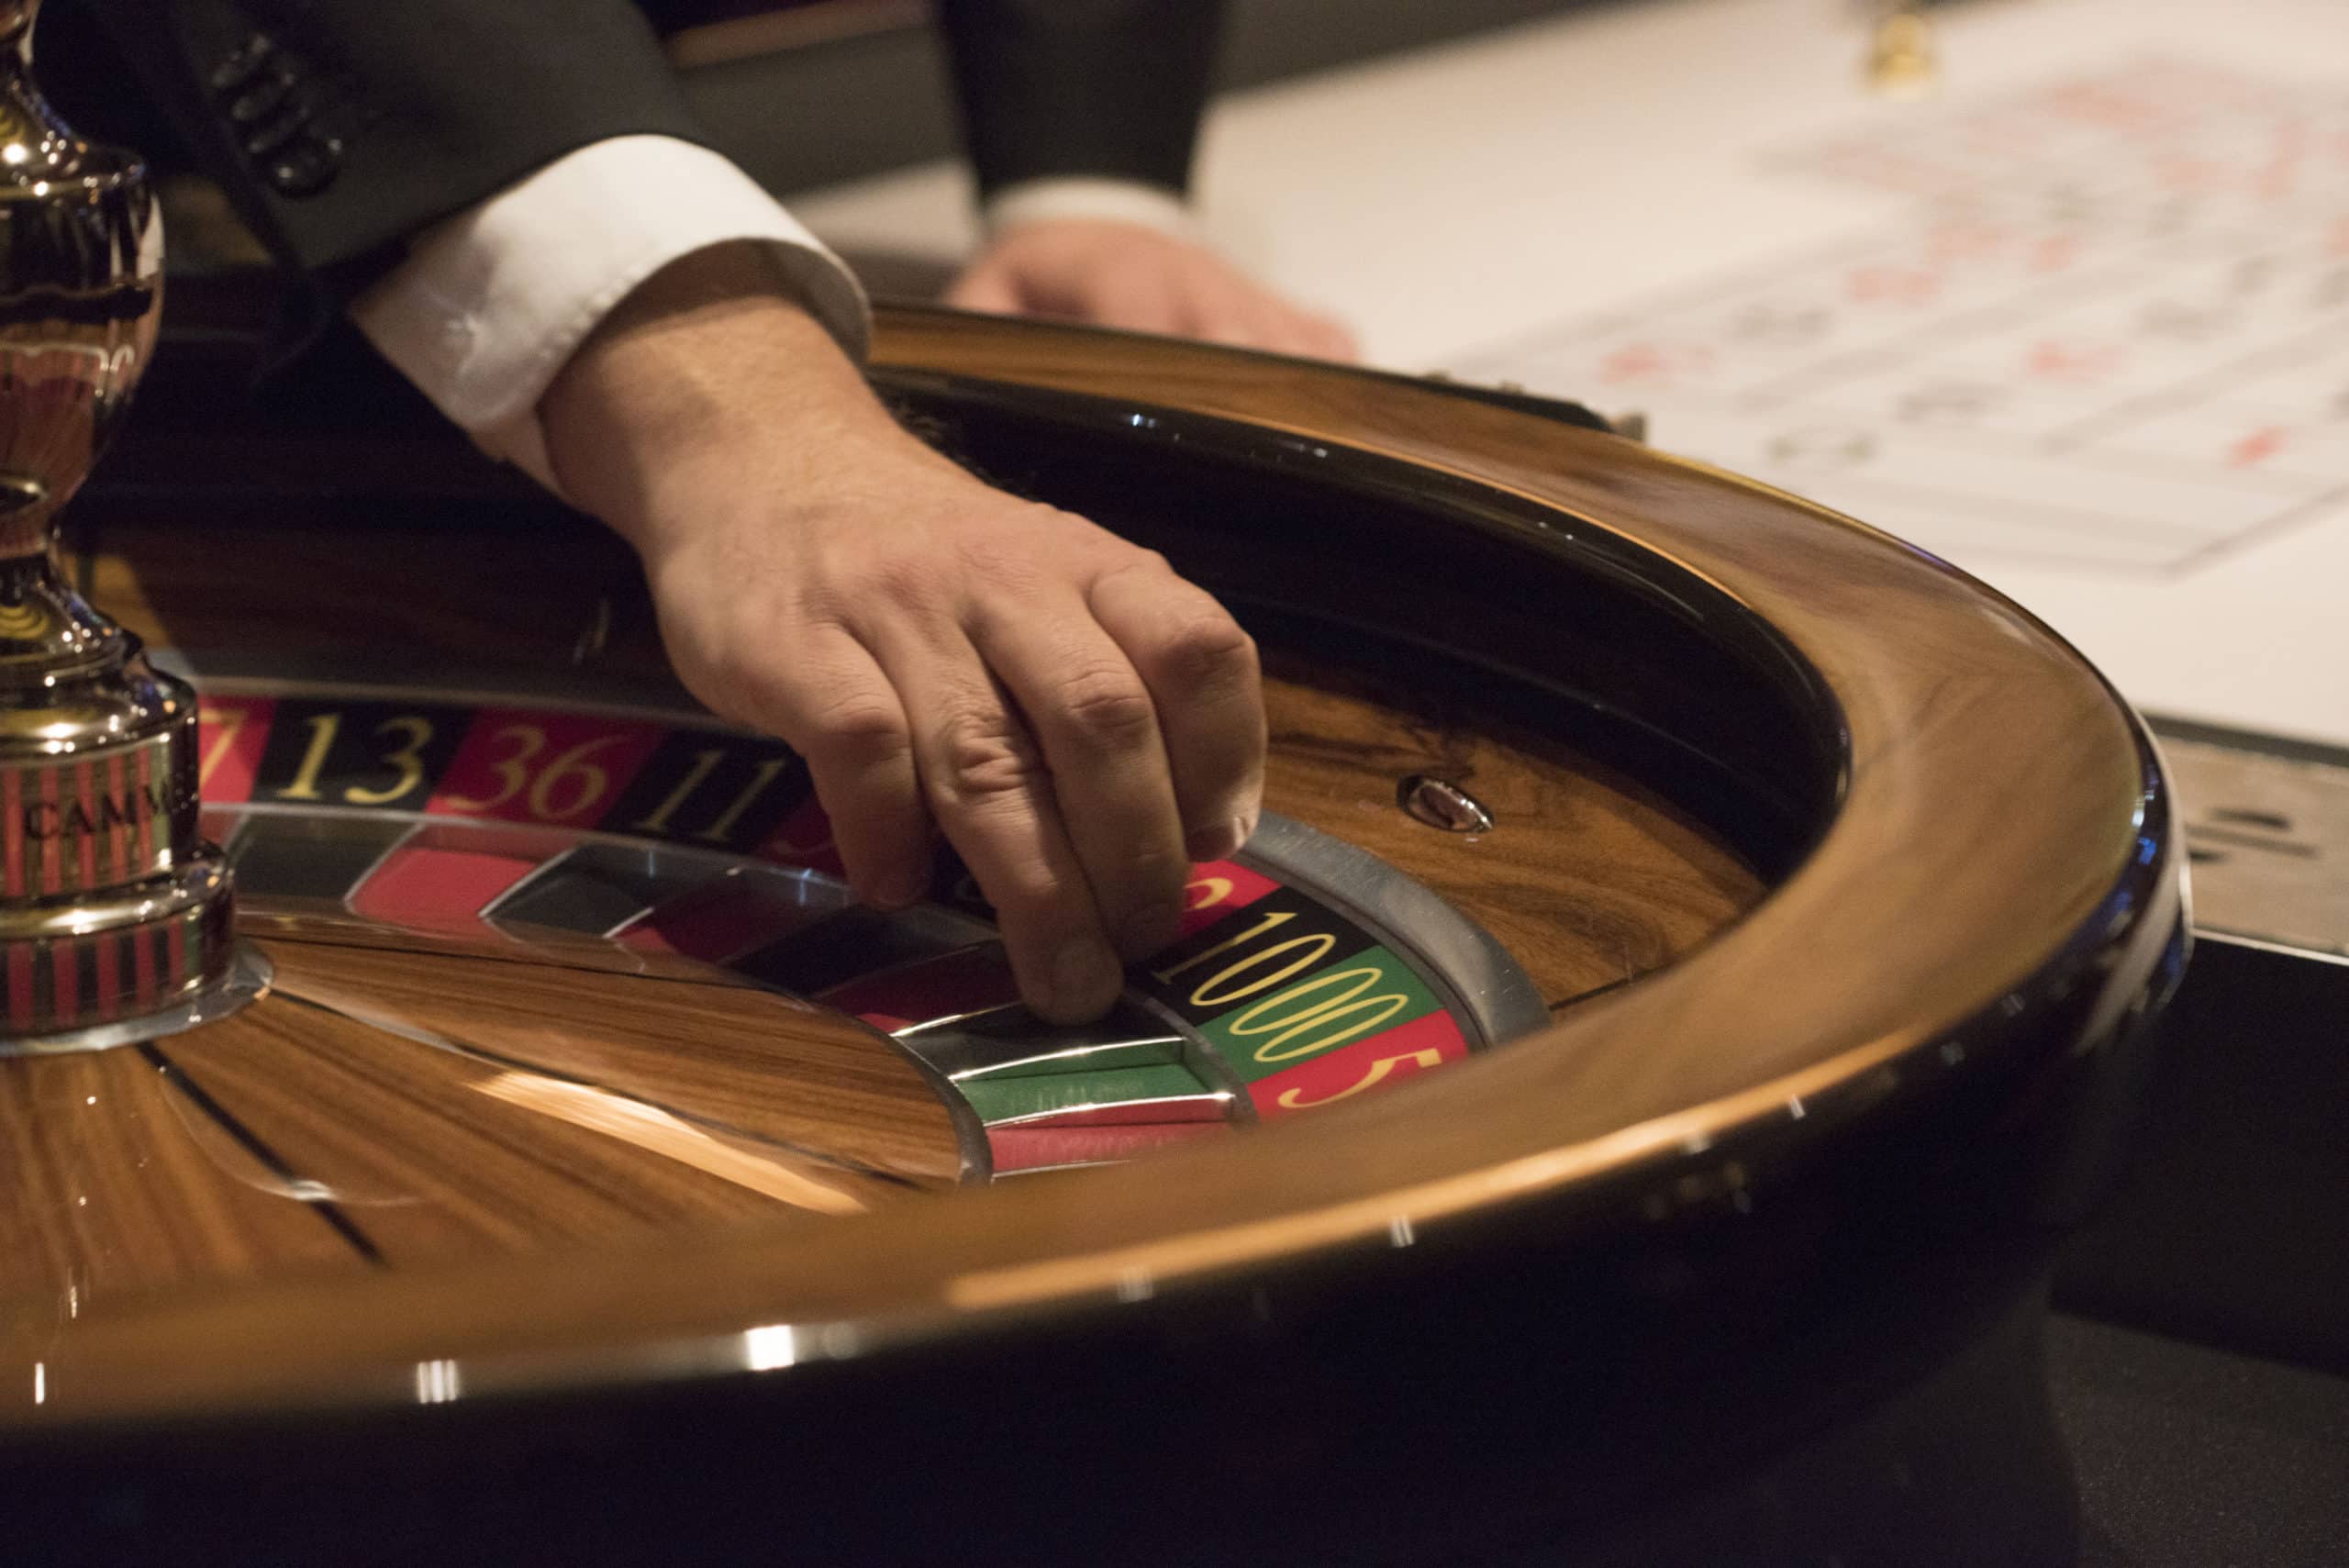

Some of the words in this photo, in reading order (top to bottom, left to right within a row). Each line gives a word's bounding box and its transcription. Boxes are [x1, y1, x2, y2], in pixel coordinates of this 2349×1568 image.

[278, 714, 434, 805] 13
[448, 725, 624, 819] 36
[635, 749, 784, 840] 11
[1152, 911, 1336, 1006] 10
[1229, 967, 1408, 1062] 00
[1277, 1047, 1442, 1108] 5
